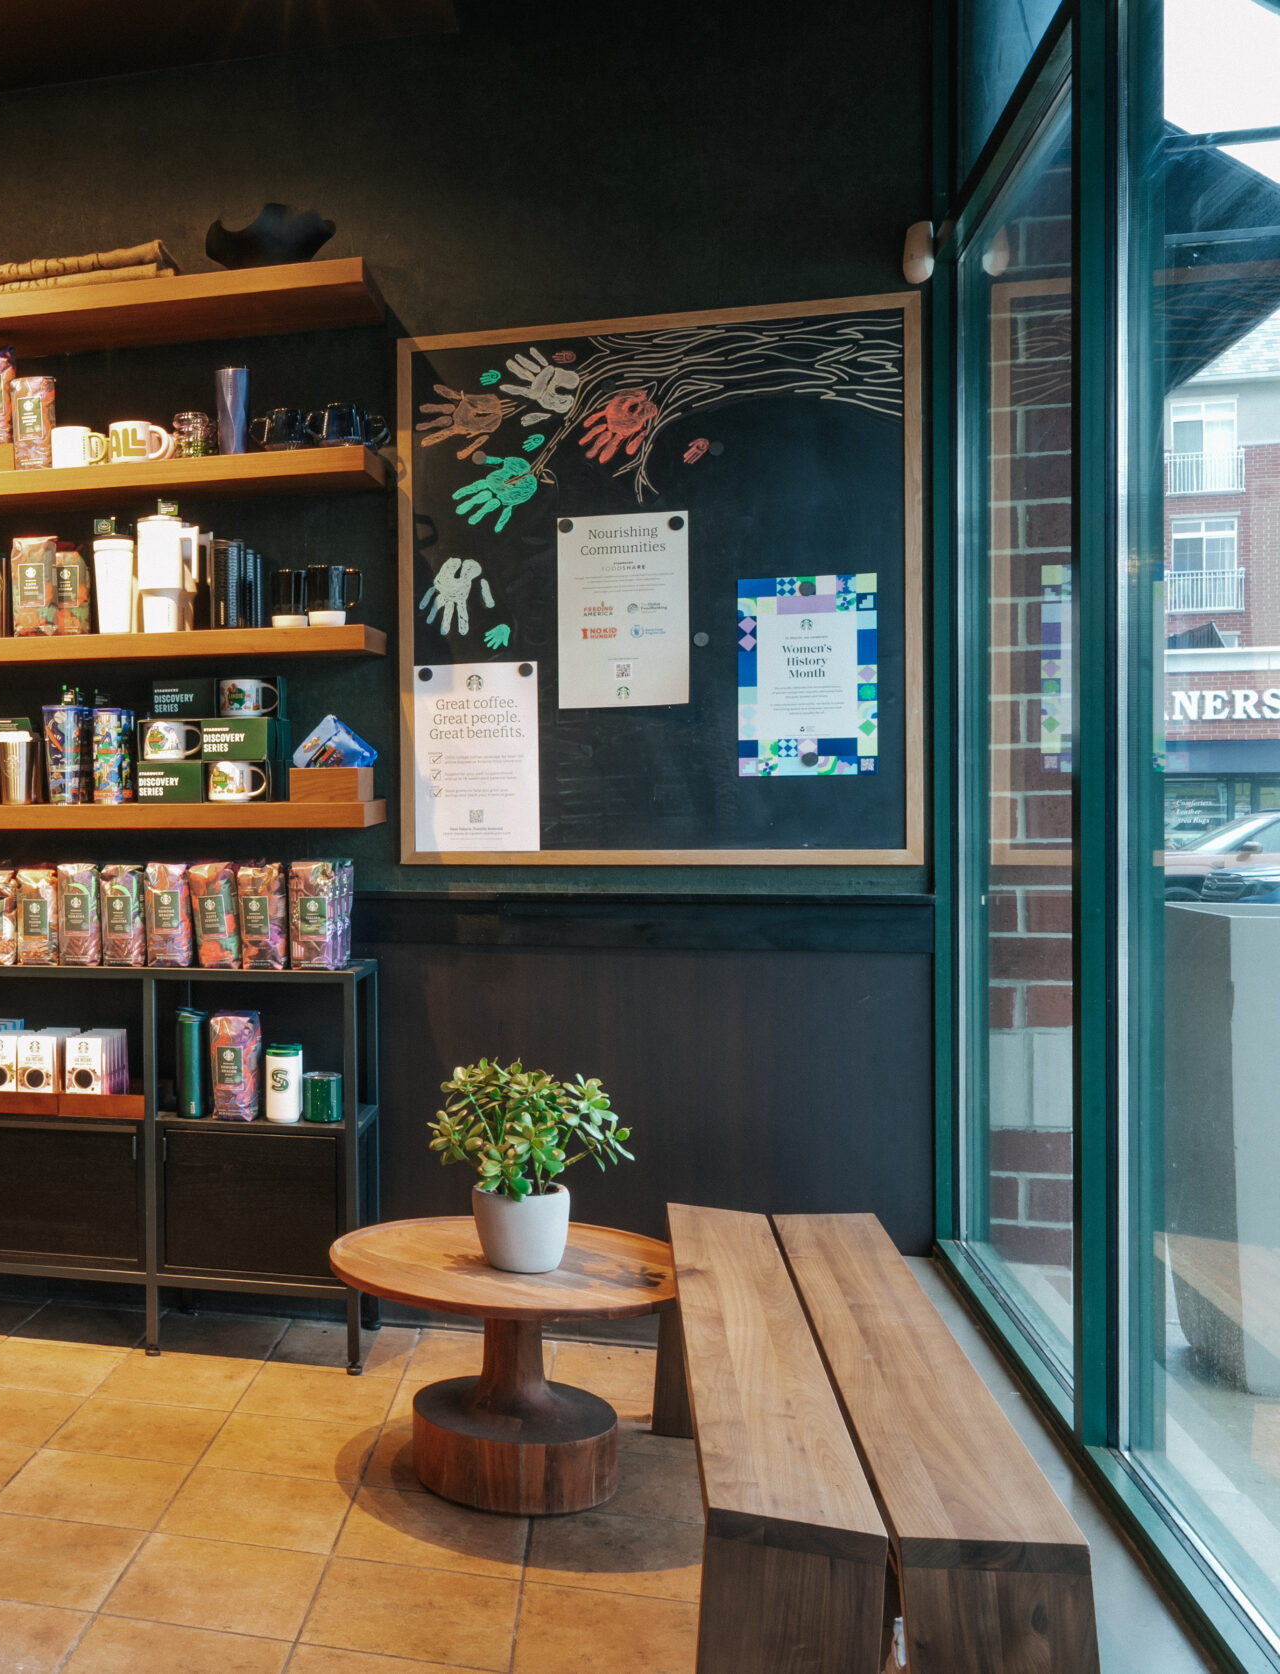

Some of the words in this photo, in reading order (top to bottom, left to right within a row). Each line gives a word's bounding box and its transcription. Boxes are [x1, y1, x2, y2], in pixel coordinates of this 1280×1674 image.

[111, 428, 147, 458] ALL
[588, 526, 658, 540] Nourishing
[580, 541, 666, 556] Communities
[782, 644, 832, 654] Women's
[787, 657, 828, 668] History
[789, 668, 826, 679] Month
[154, 693, 194, 703] DISCOVERY
[435, 698, 470, 711] Great
[472, 696, 518, 709] coffee.
[154, 703, 179, 713] SERIES
[1164, 688, 1280, 720] NERS
[433, 713, 468, 726] Great
[470, 711, 521, 727] people.
[203, 733, 246, 743] DISCOVERY
[429, 728, 468, 740] Great
[468, 726, 526, 739] benefits.
[203, 743, 229, 753] SERIES
[138, 777, 179, 787] DISCOVERY
[138, 787, 164, 796] SERIES
